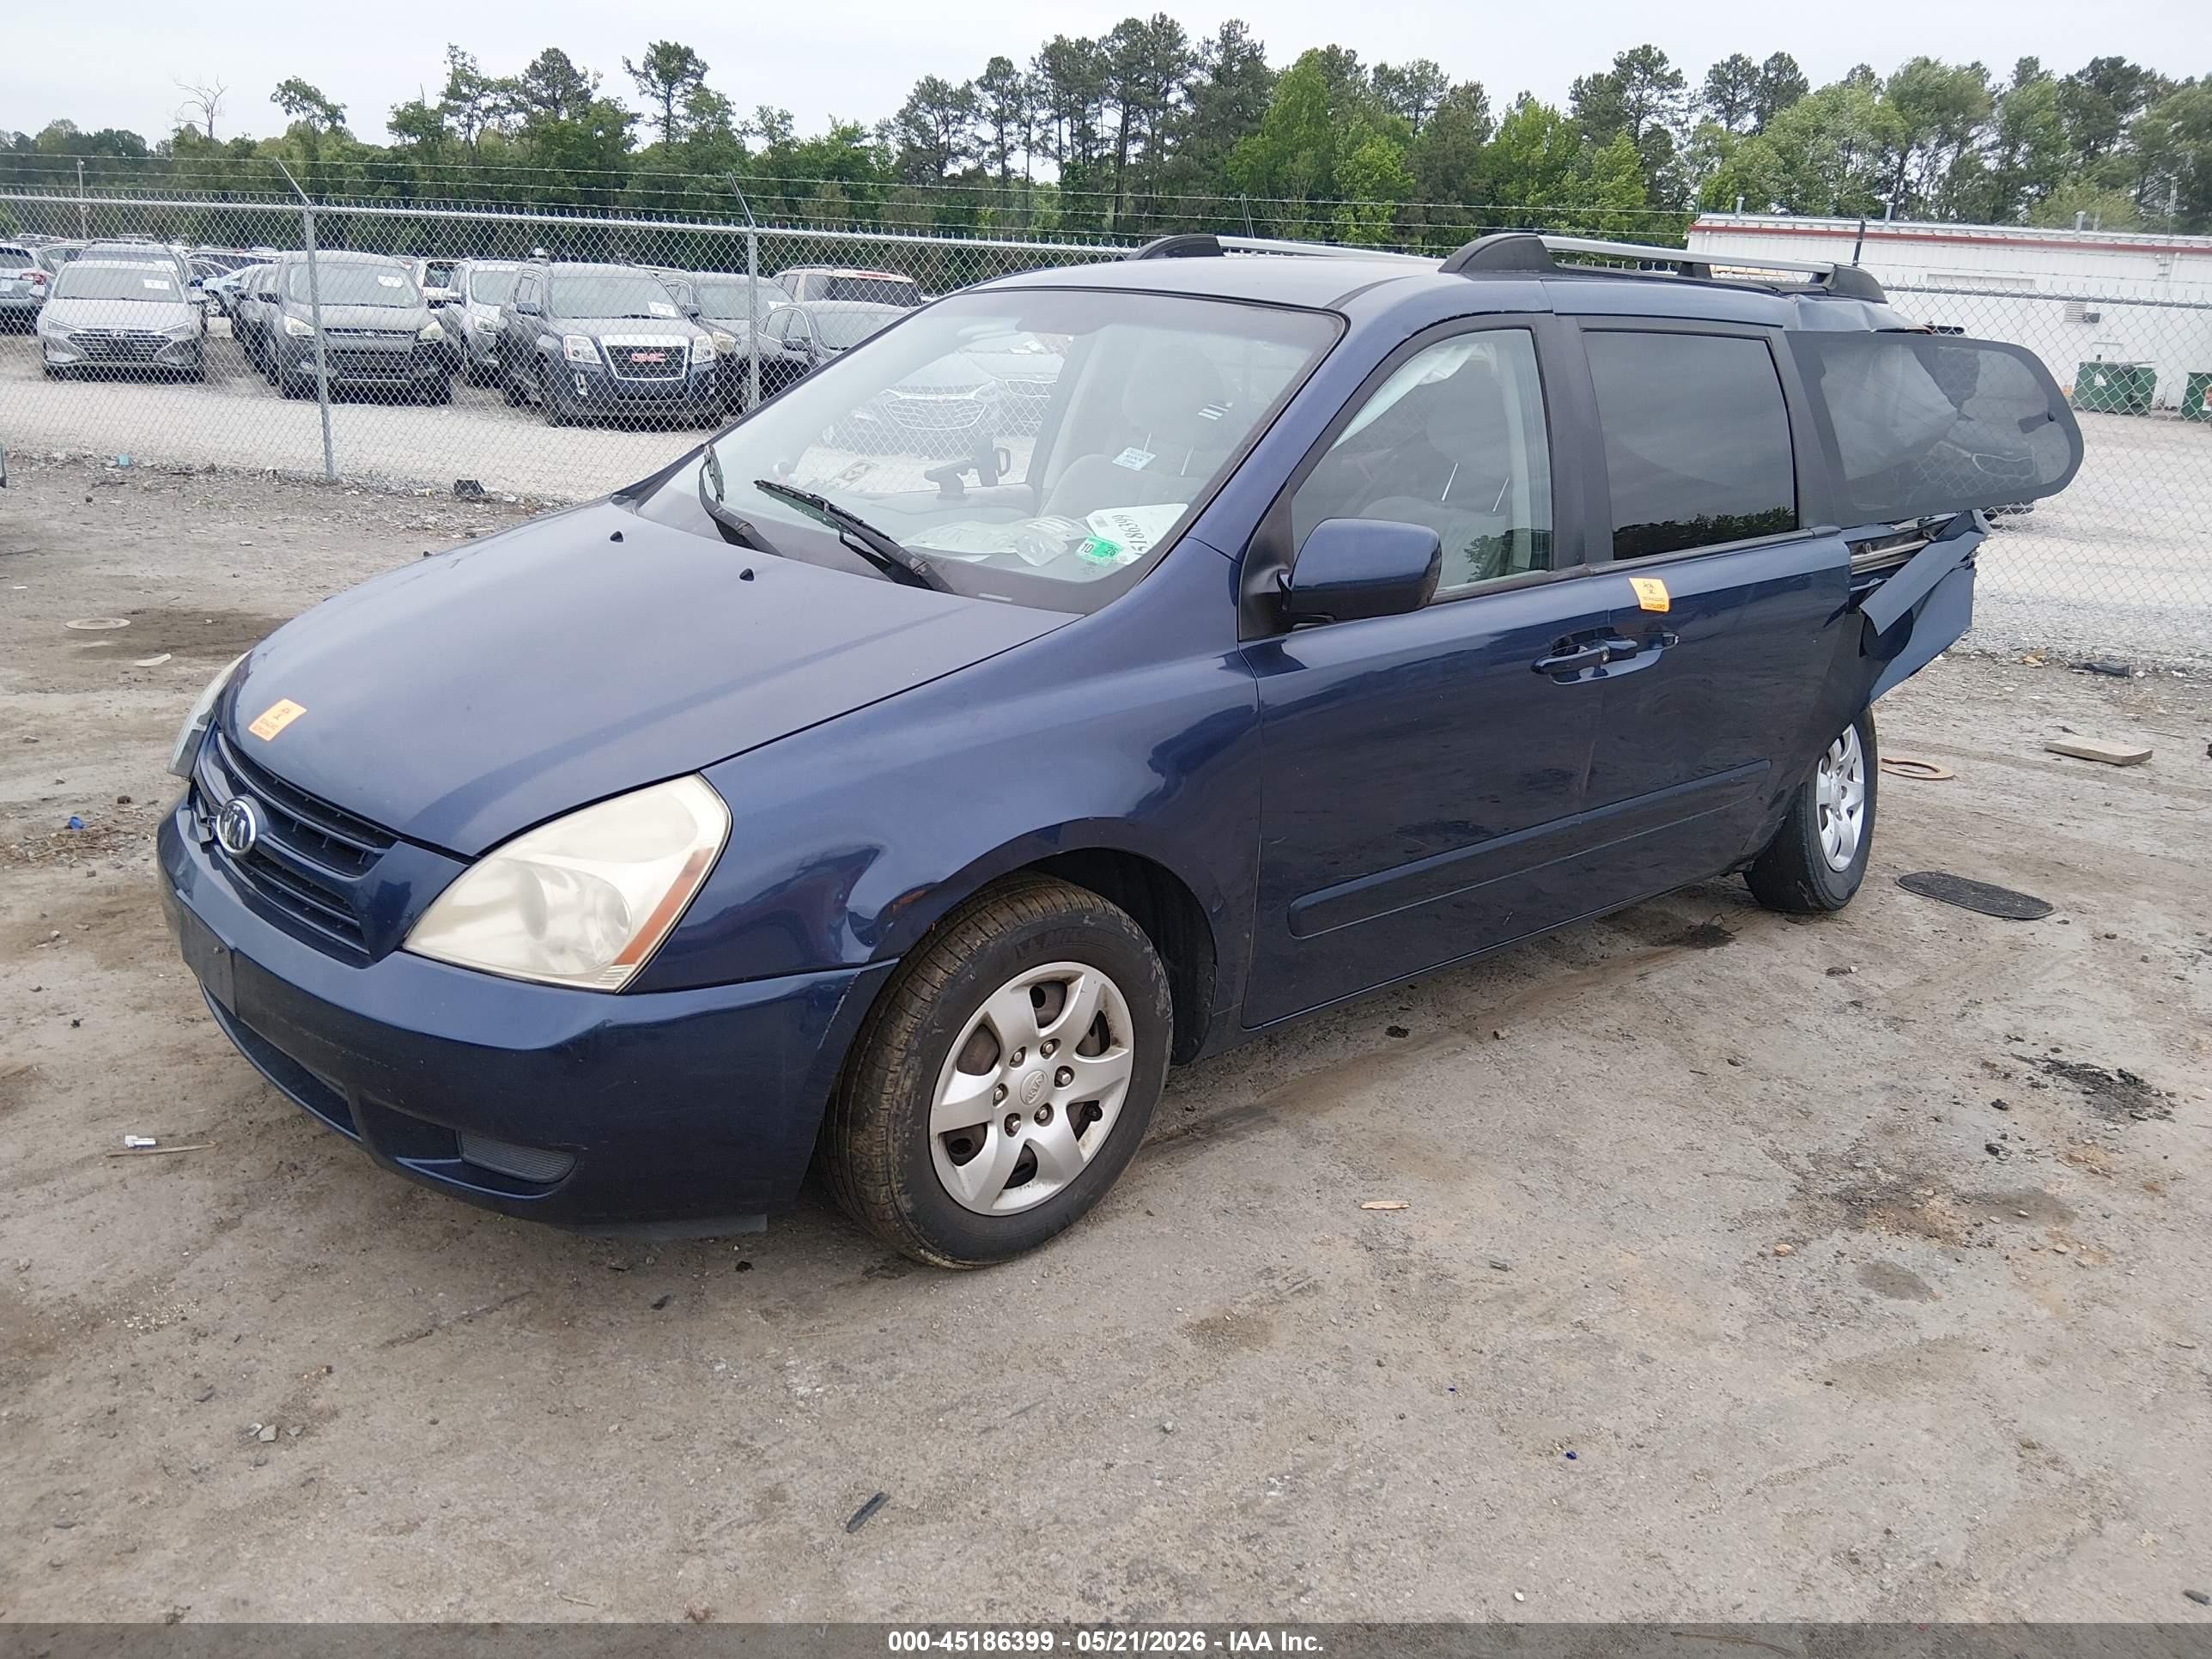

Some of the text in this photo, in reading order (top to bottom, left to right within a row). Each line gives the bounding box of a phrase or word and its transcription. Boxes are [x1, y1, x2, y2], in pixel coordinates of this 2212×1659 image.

[631, 353, 665, 362] GMC
[1081, 543, 1094, 553] 10
[1025, 1073, 1045, 1103] KIA
